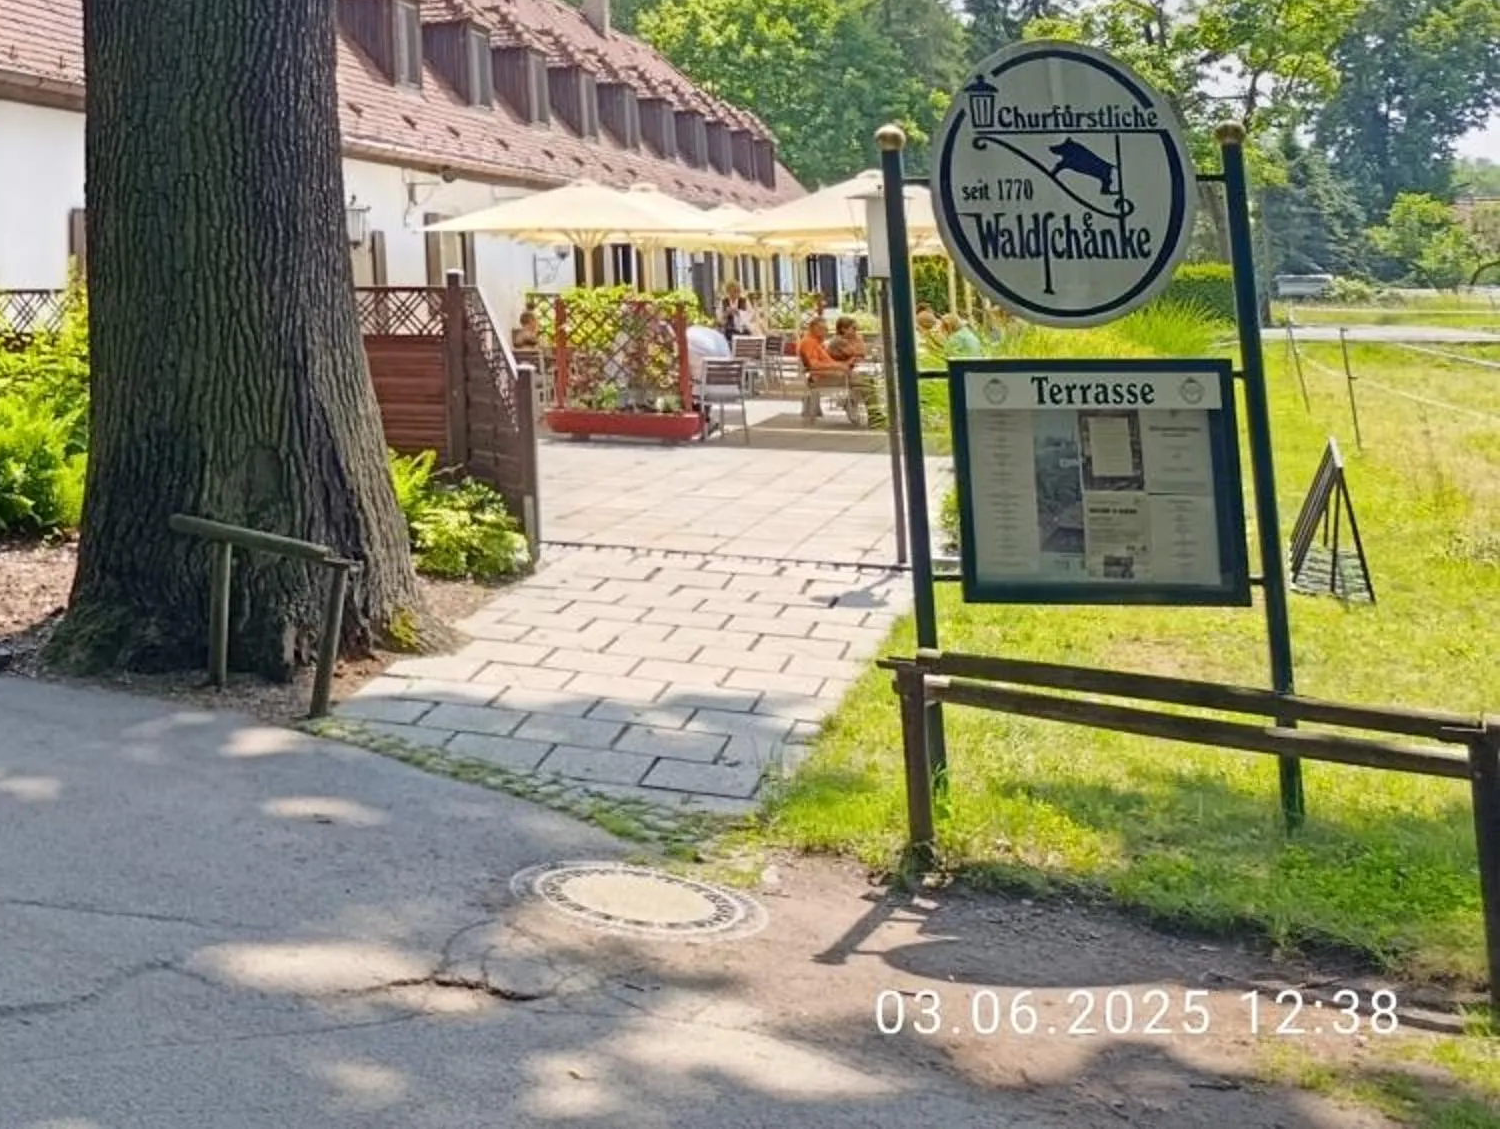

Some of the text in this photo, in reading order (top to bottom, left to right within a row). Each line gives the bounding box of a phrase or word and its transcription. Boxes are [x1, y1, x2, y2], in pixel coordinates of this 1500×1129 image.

[962, 179, 1034, 201] seit 1770
[1031, 375, 1155, 405] Terrasse
